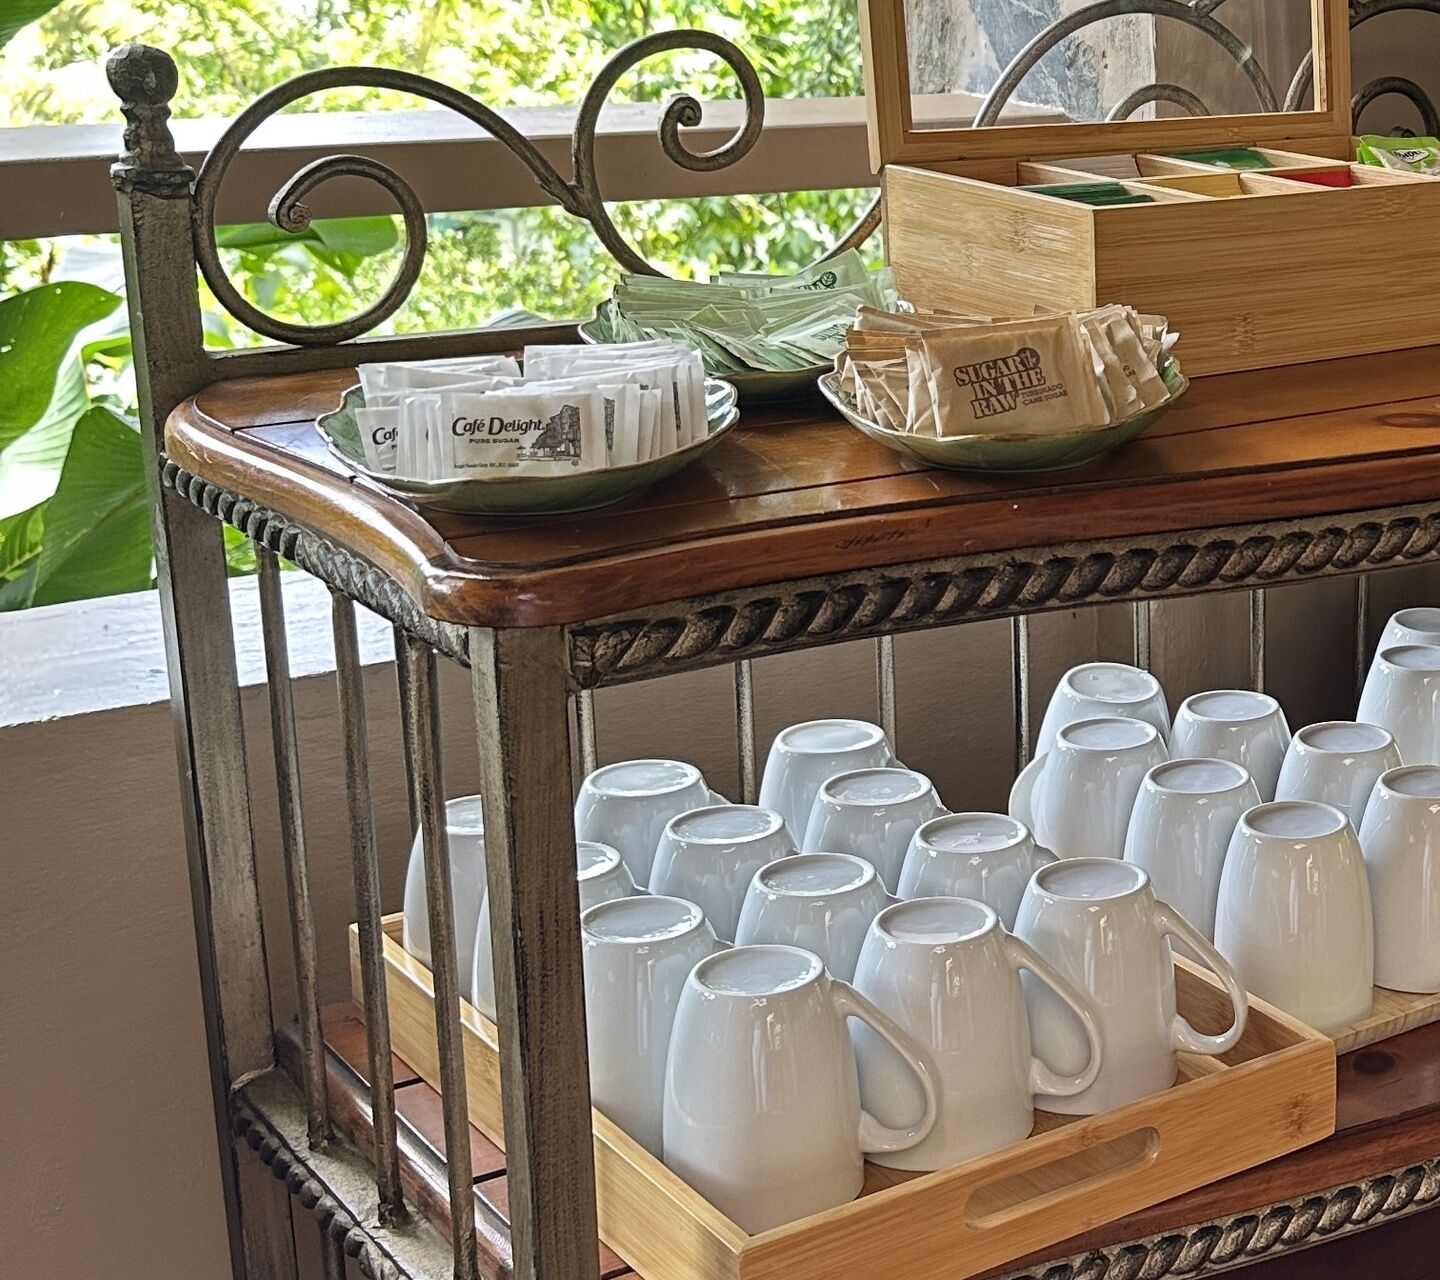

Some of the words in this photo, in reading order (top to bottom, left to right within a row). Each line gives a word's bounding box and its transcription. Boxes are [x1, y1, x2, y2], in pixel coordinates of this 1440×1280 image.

[954, 355, 1026, 387] SUGAR
[971, 380, 999, 400] IN
[997, 368, 1046, 393] THE
[971, 391, 1019, 419] RAW
[452, 417, 485, 436] Café
